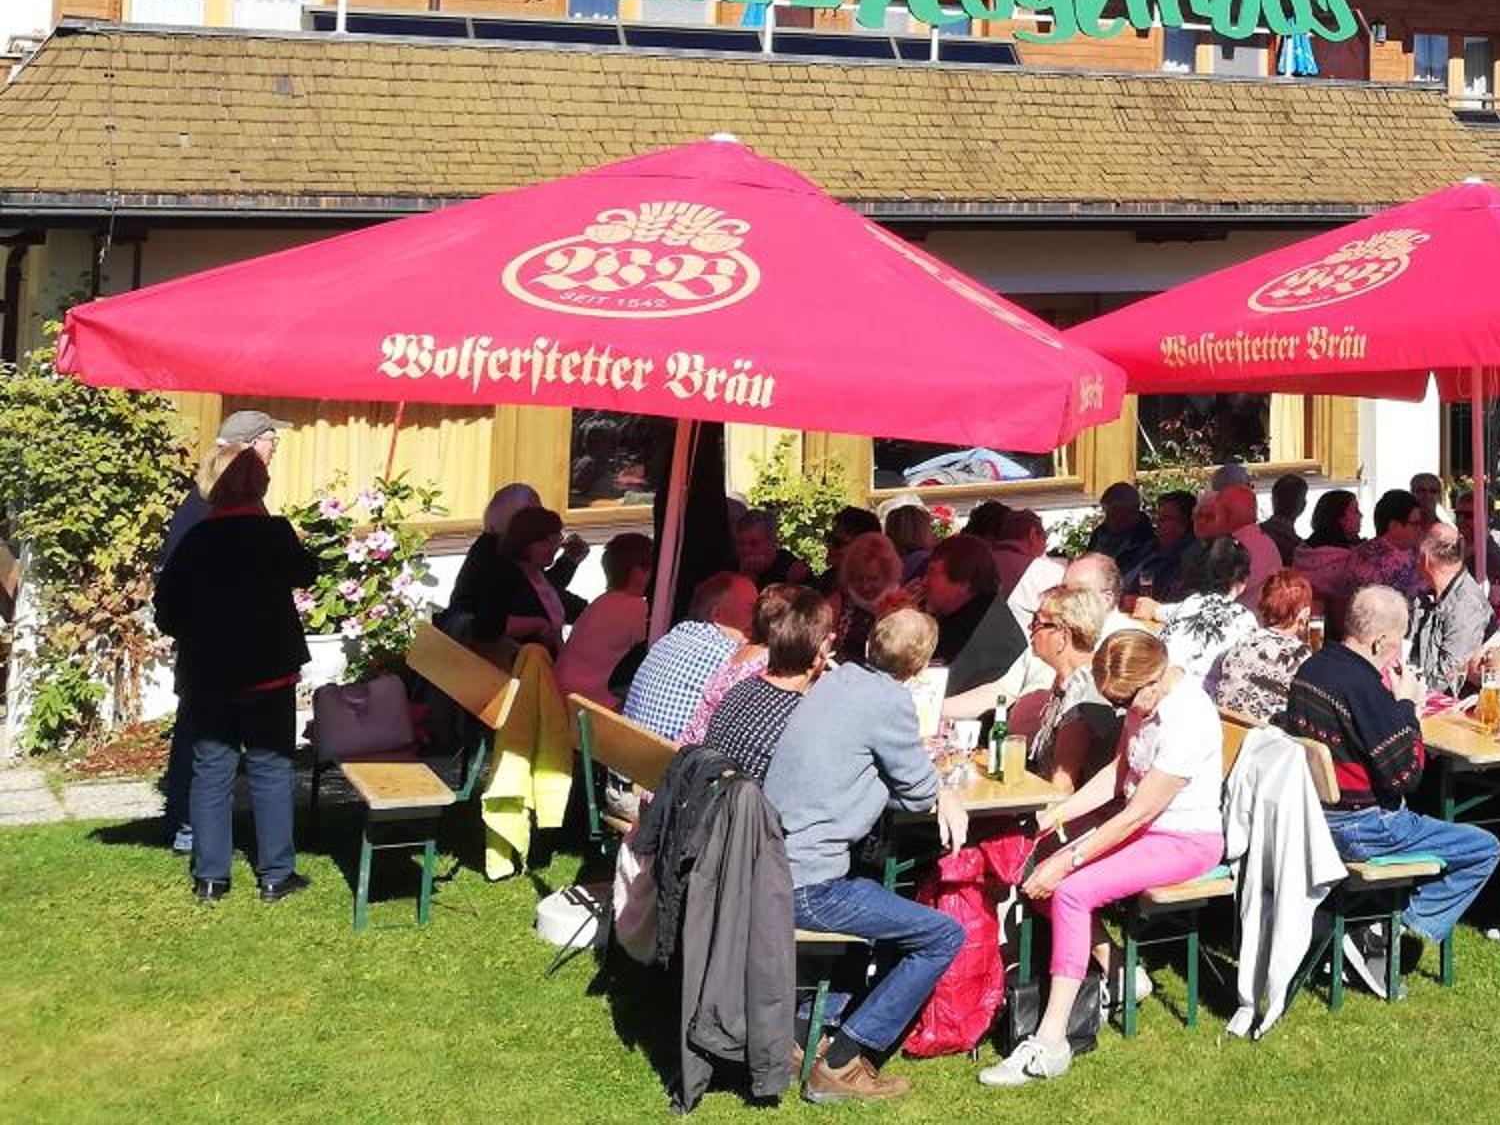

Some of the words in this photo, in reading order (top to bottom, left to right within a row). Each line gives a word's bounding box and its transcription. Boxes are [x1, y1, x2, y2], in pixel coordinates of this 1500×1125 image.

[559, 290, 610, 304] SEIT
[1306, 325, 1367, 360] Bräu
[662, 350, 775, 409] Bräu
